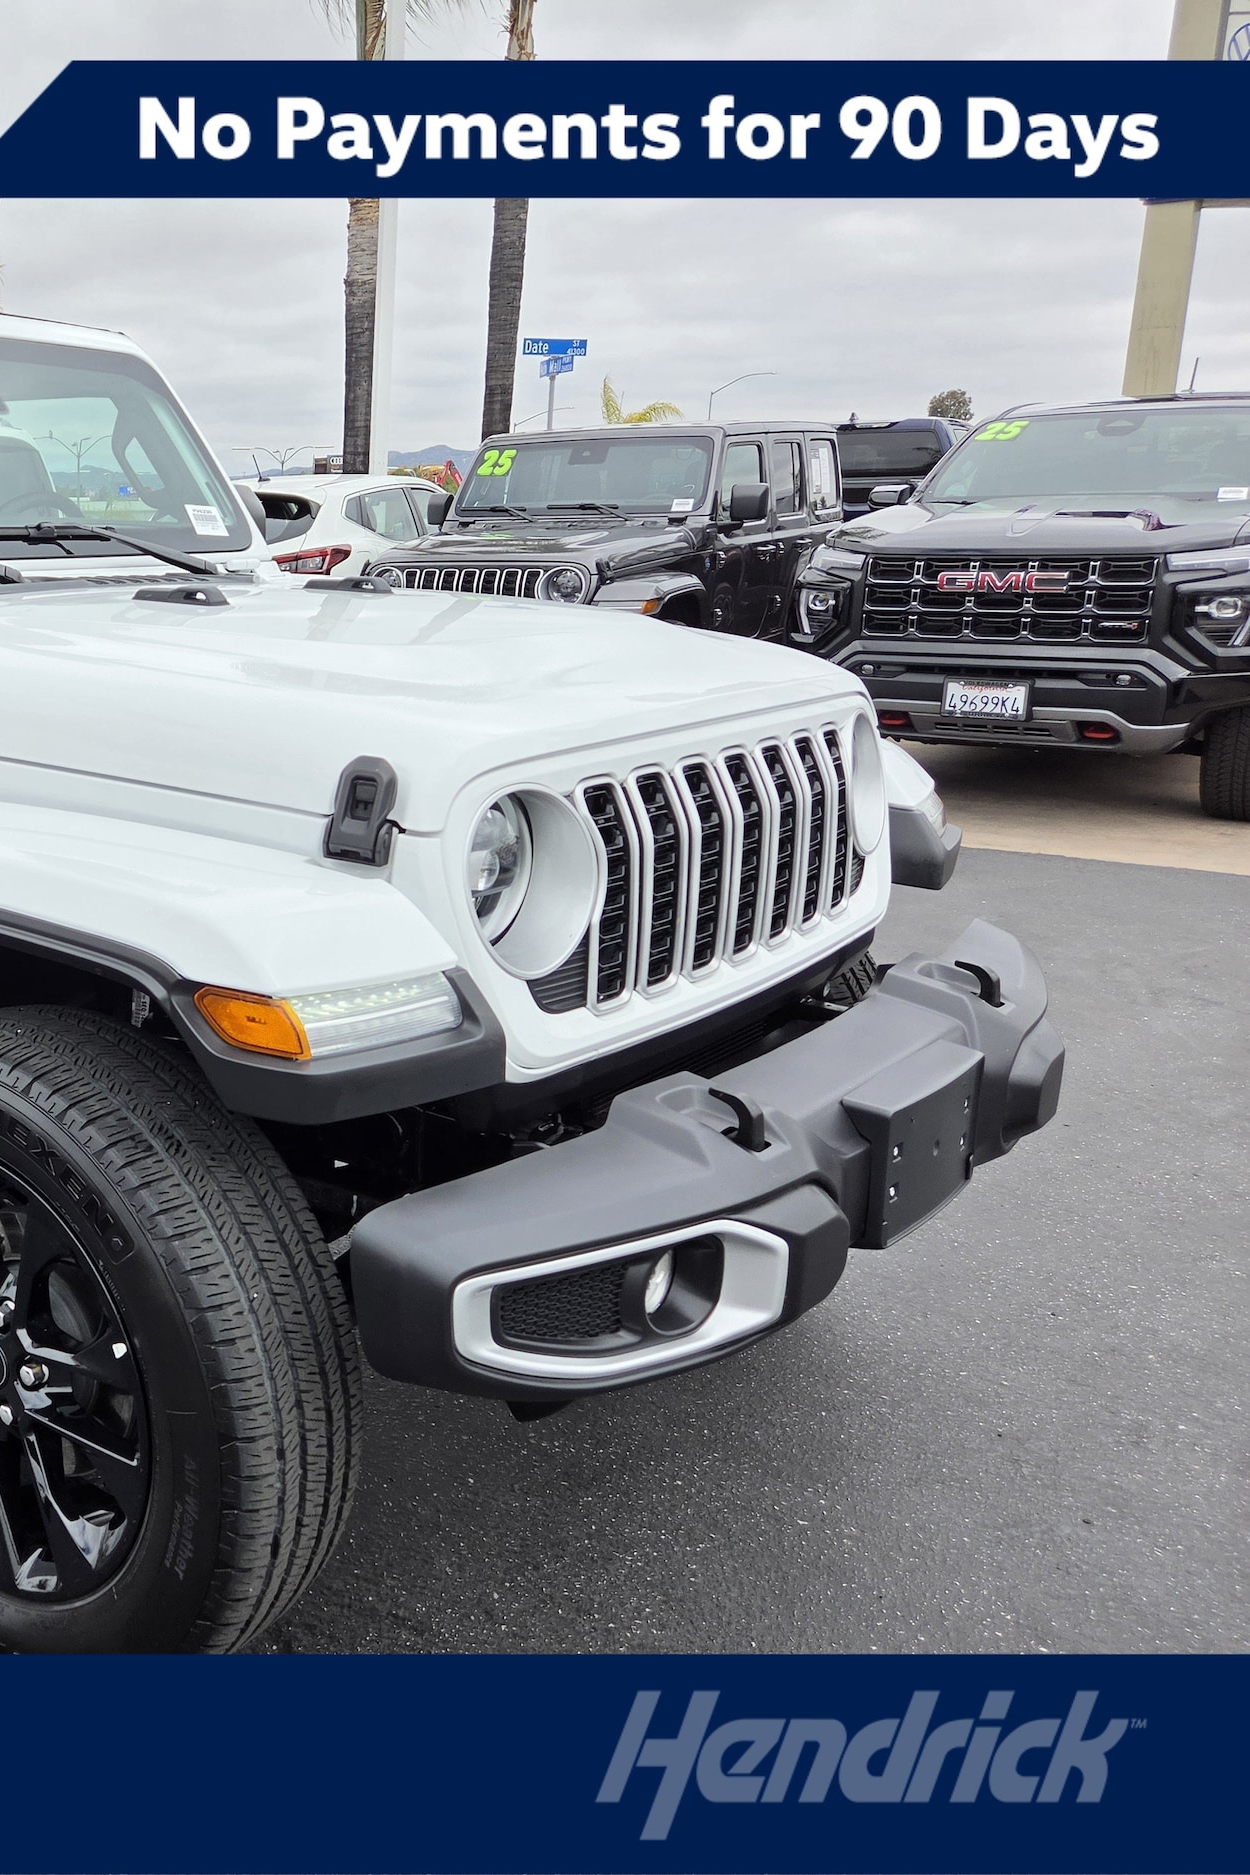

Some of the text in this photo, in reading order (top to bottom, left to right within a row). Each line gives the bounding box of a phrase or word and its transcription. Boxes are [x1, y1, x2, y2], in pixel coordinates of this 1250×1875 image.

[525, 340, 549, 354] Date
[974, 420, 1030, 441] 25
[477, 449, 517, 476] 25
[937, 571, 1070, 593] GMC
[948, 692, 1021, 714] 49699K4
